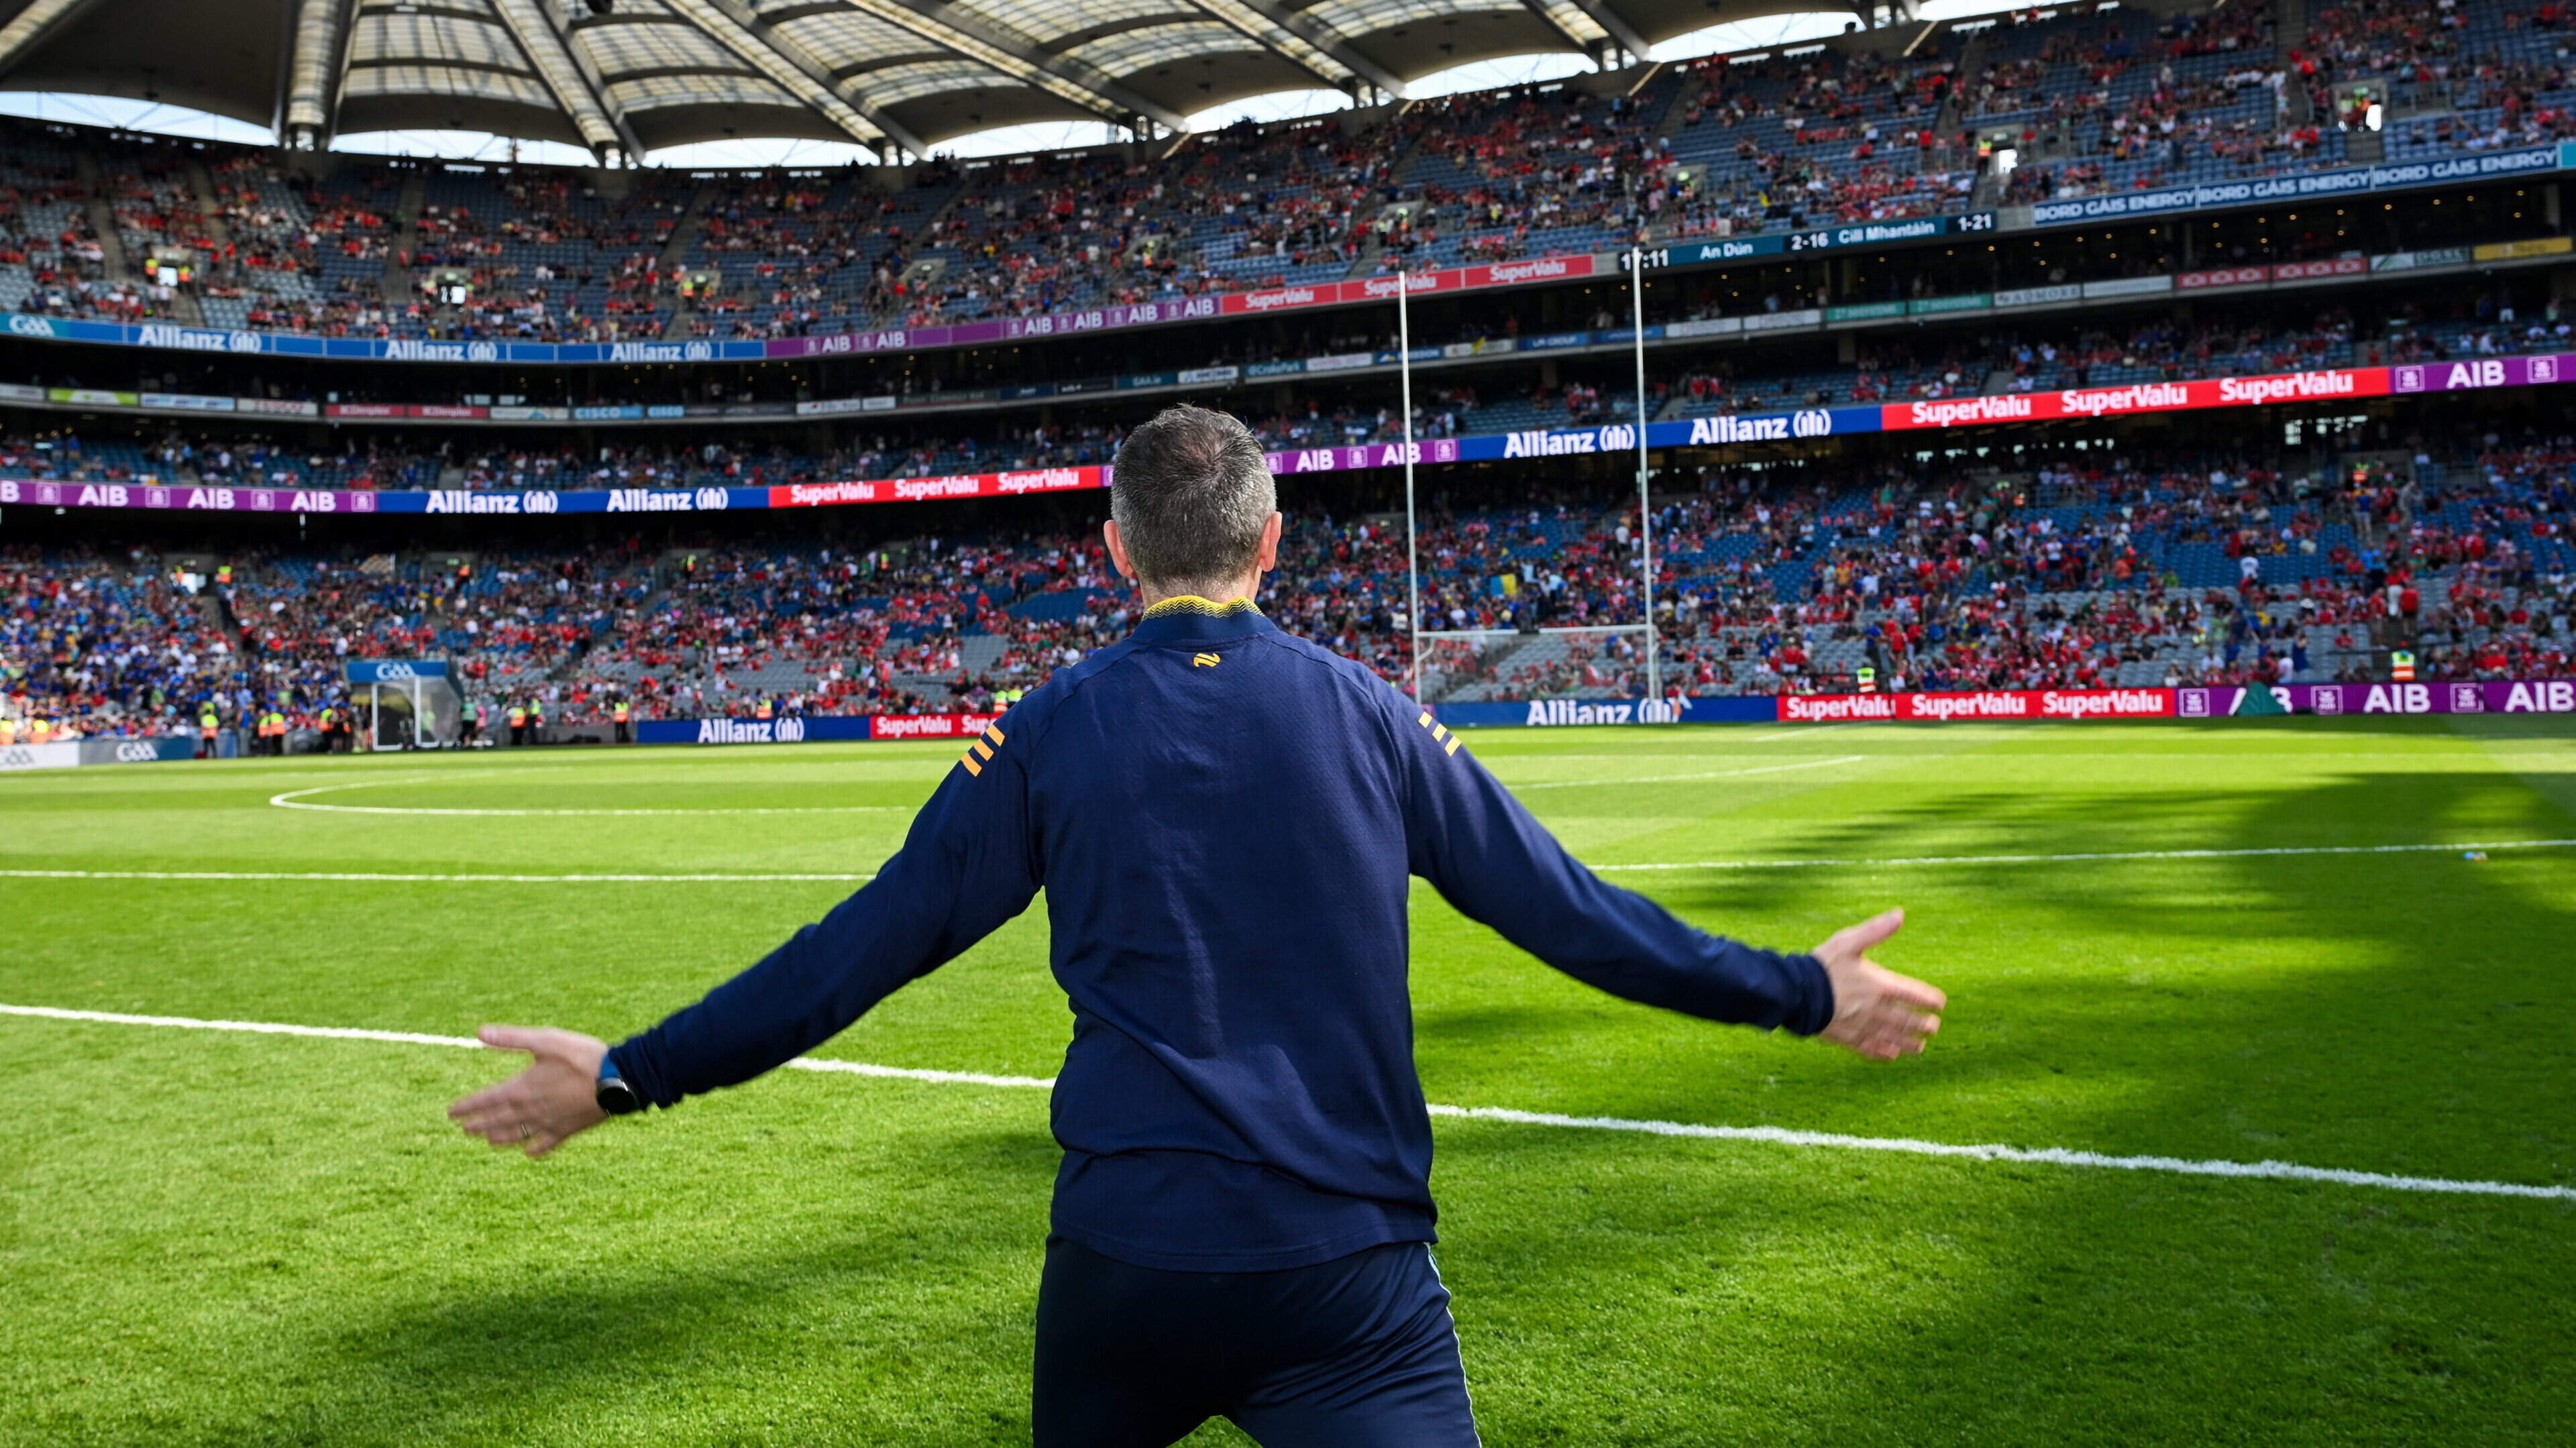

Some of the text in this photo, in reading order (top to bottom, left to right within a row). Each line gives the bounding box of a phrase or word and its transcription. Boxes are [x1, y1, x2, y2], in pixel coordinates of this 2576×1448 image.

[2375, 151, 2557, 183] BORD GÁIS ENERGY
[2199, 172, 2369, 202] BORD GÁIS ENERGY
[2035, 190, 2194, 222] BORD GÁIS ENERGY
[1701, 246, 1721, 260] An
[1723, 241, 1754, 257] Dún
[1792, 233, 1829, 250] 2-16
[1839, 228, 1864, 243] Cill
[1866, 221, 1935, 240] Mhantáin
[1959, 213, 1992, 231] 1-21
[1489, 260, 1566, 283] SuperValu
[1184, 298, 1214, 317] AIB
[1245, 288, 1314, 311] SuperValu
[1024, 317, 1053, 335] AIB
[1074, 311, 1103, 330] AIB
[1128, 304, 1158, 324] AIB
[138, 325, 226, 350] Allianz
[385, 339, 464, 361] Allianz
[822, 335, 851, 353] AIB
[877, 331, 906, 349] AIB
[610, 341, 682, 362] Allianz
[2220, 370, 2353, 404] SuperValu
[2446, 360, 2506, 389] AIB
[1912, 396, 2031, 427] SuperValu
[2061, 382, 2188, 416] SuperValu
[1689, 415, 1789, 445] Allianz
[1381, 442, 1421, 465] AIB
[1504, 430, 1595, 459] Allianz
[1295, 449, 1335, 472] AIB
[895, 475, 979, 499] SuperValu
[998, 467, 1079, 494] SuperValu
[78, 484, 129, 506] AIB
[187, 487, 235, 510] AIB
[290, 492, 337, 512] AIB
[425, 489, 520, 514] Allianz
[606, 489, 692, 512] Allianz
[790, 482, 875, 506] SuperValu
[1786, 693, 1895, 722] SuperValu
[1911, 692, 2026, 720] SuperValu
[2043, 689, 2163, 720] SuperValu
[2363, 684, 2431, 713] AIB
[2504, 681, 2574, 712] AIB
[876, 715, 951, 736] SuperValu
[1526, 700, 1632, 726] Allianz
[698, 718, 771, 743] Allianz
